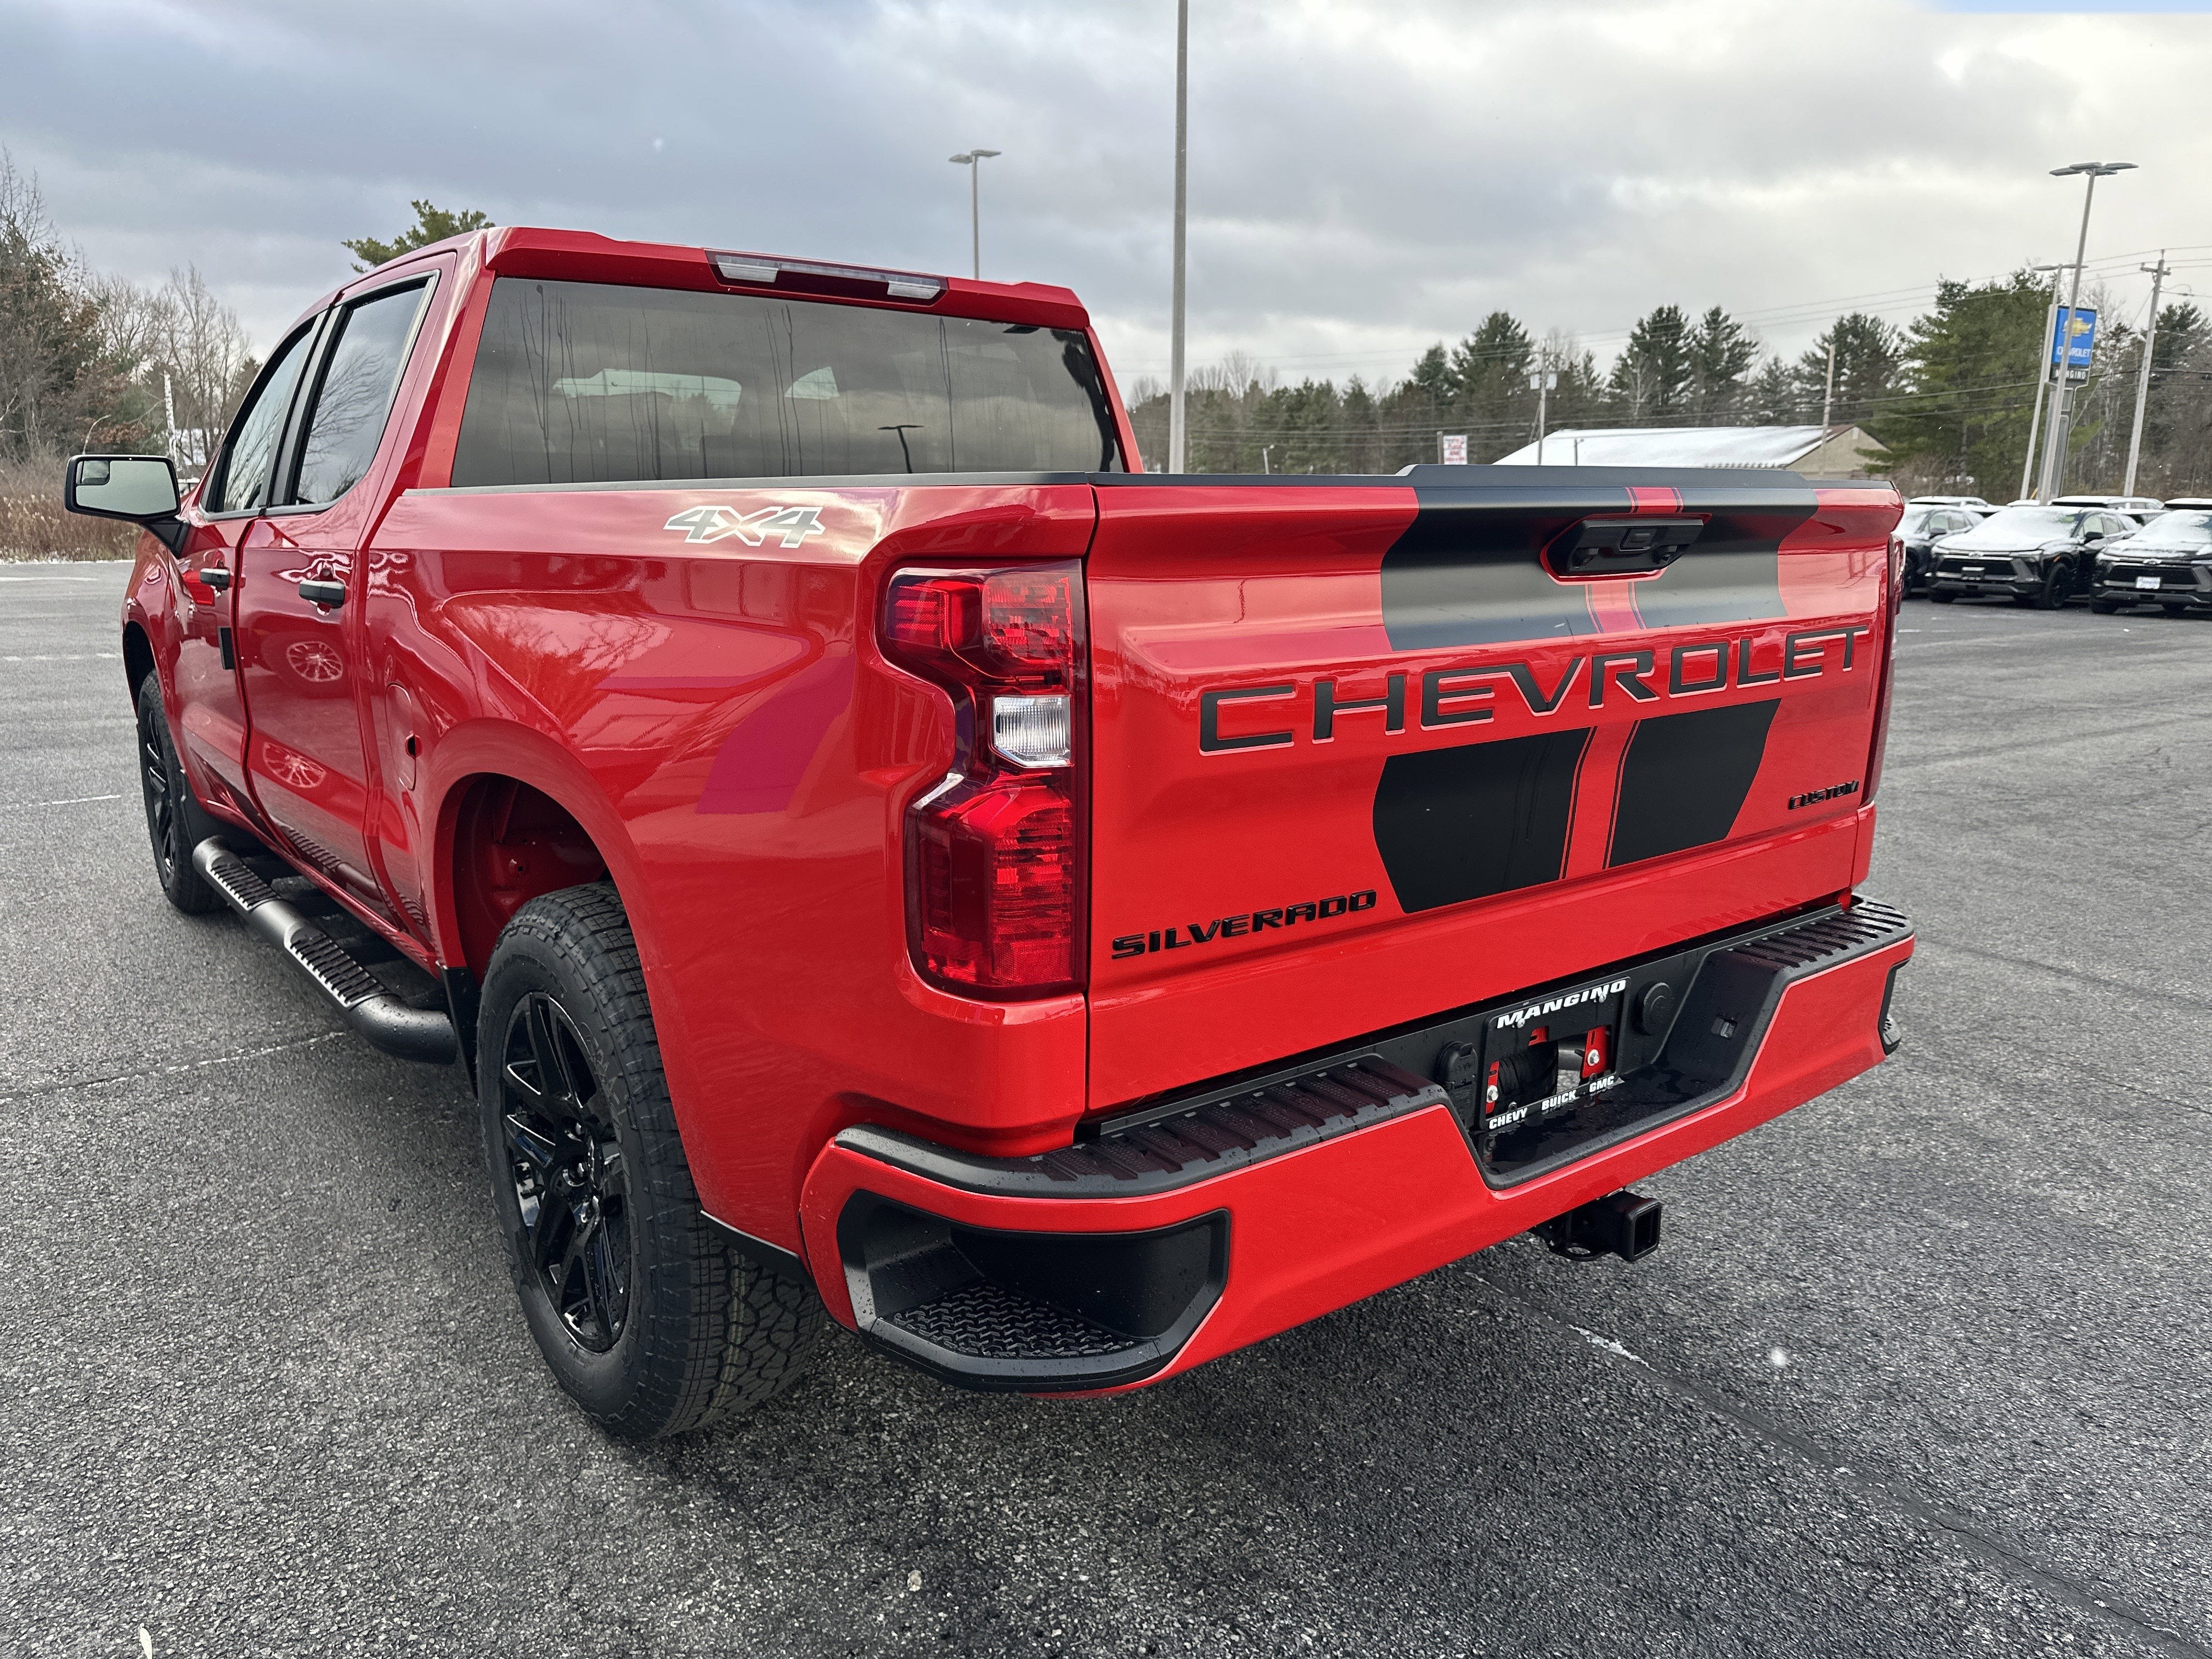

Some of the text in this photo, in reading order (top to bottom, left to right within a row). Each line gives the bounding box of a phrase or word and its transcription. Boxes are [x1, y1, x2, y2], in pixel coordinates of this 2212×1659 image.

[2055, 369, 2086, 380] MNGINO
[2057, 346, 2091, 358] CROLET
[1199, 627, 1870, 756] CHEVROLET
[1788, 779, 1860, 810] CUSTOM
[1111, 889, 1377, 960] SILVERADO
[1497, 979, 1627, 1029] MANGINO
[1488, 1075, 1615, 1130] CHEVY BUICK GMC
